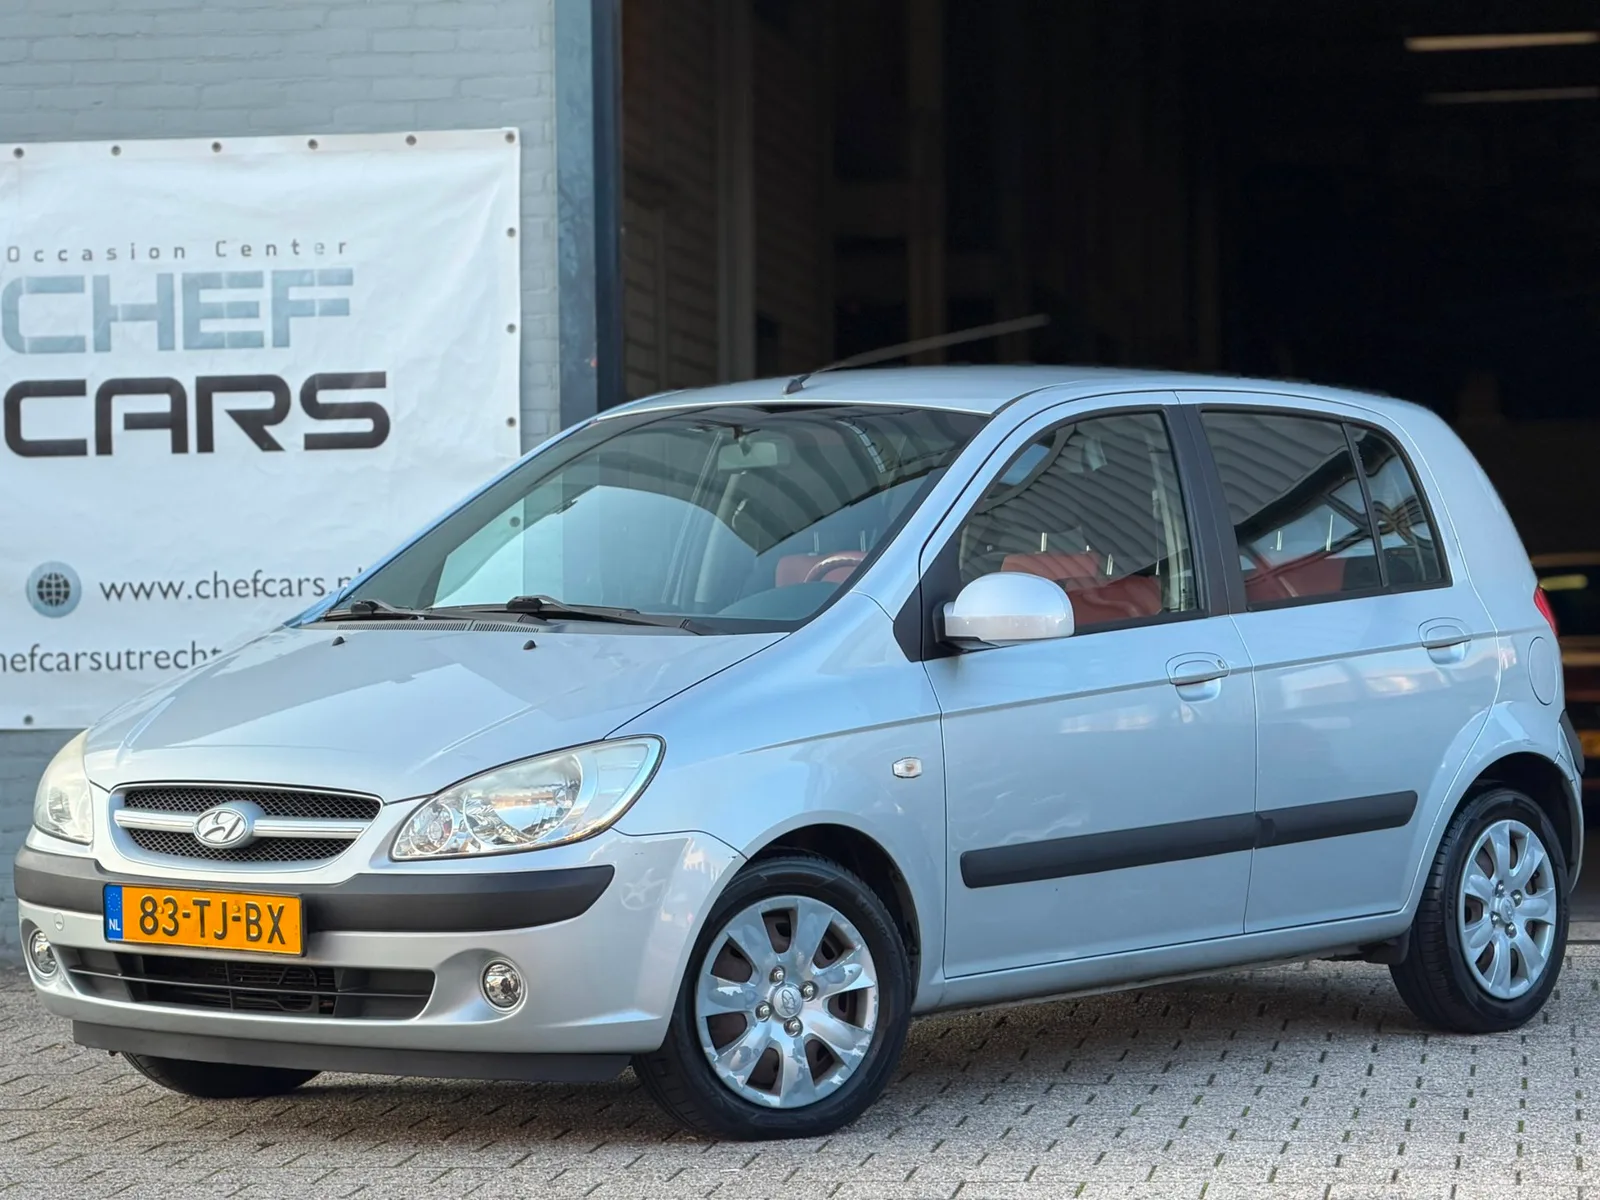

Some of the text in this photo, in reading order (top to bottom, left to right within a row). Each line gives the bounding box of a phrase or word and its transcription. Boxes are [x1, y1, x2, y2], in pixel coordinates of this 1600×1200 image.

[6, 240, 348, 263] Occasion Center
[1, 268, 354, 354] CHEF
[3, 371, 391, 457] CARS
[100, 567, 361, 600] www.chefcars.
[108, 918, 121, 931] NL
[139, 895, 286, 944] 83-TJ-BX
